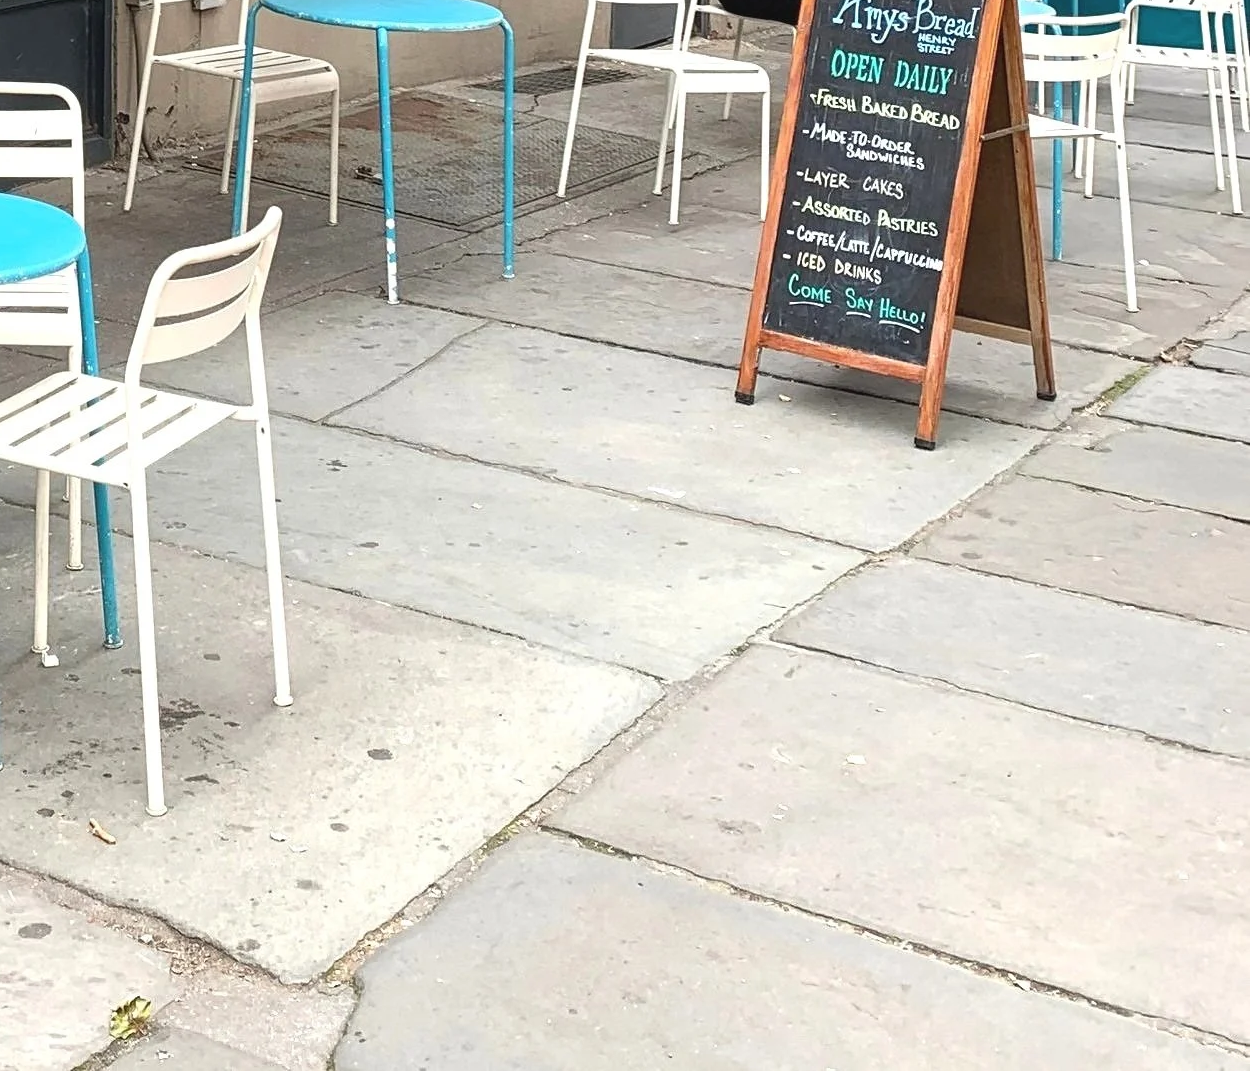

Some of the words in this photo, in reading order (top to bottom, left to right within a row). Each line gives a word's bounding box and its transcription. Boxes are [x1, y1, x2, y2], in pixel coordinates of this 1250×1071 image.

[917, 43, 955, 55] STREET
[918, 33, 957, 47] HENRY
[830, 49, 884, 84] OPEN
[894, 60, 953, 95] DAILY
[862, 96, 909, 120] BAKED
[910, 103, 961, 130] BREAD
[846, 144, 925, 170] SANDWICHES
[862, 176, 904, 200] CAKES
[877, 209, 939, 237] PASTRIES
[796, 251, 826, 273] ICED
[834, 258, 882, 285] DRINKS
[788, 273, 832, 304] COME
[845, 287, 873, 311] SAY
